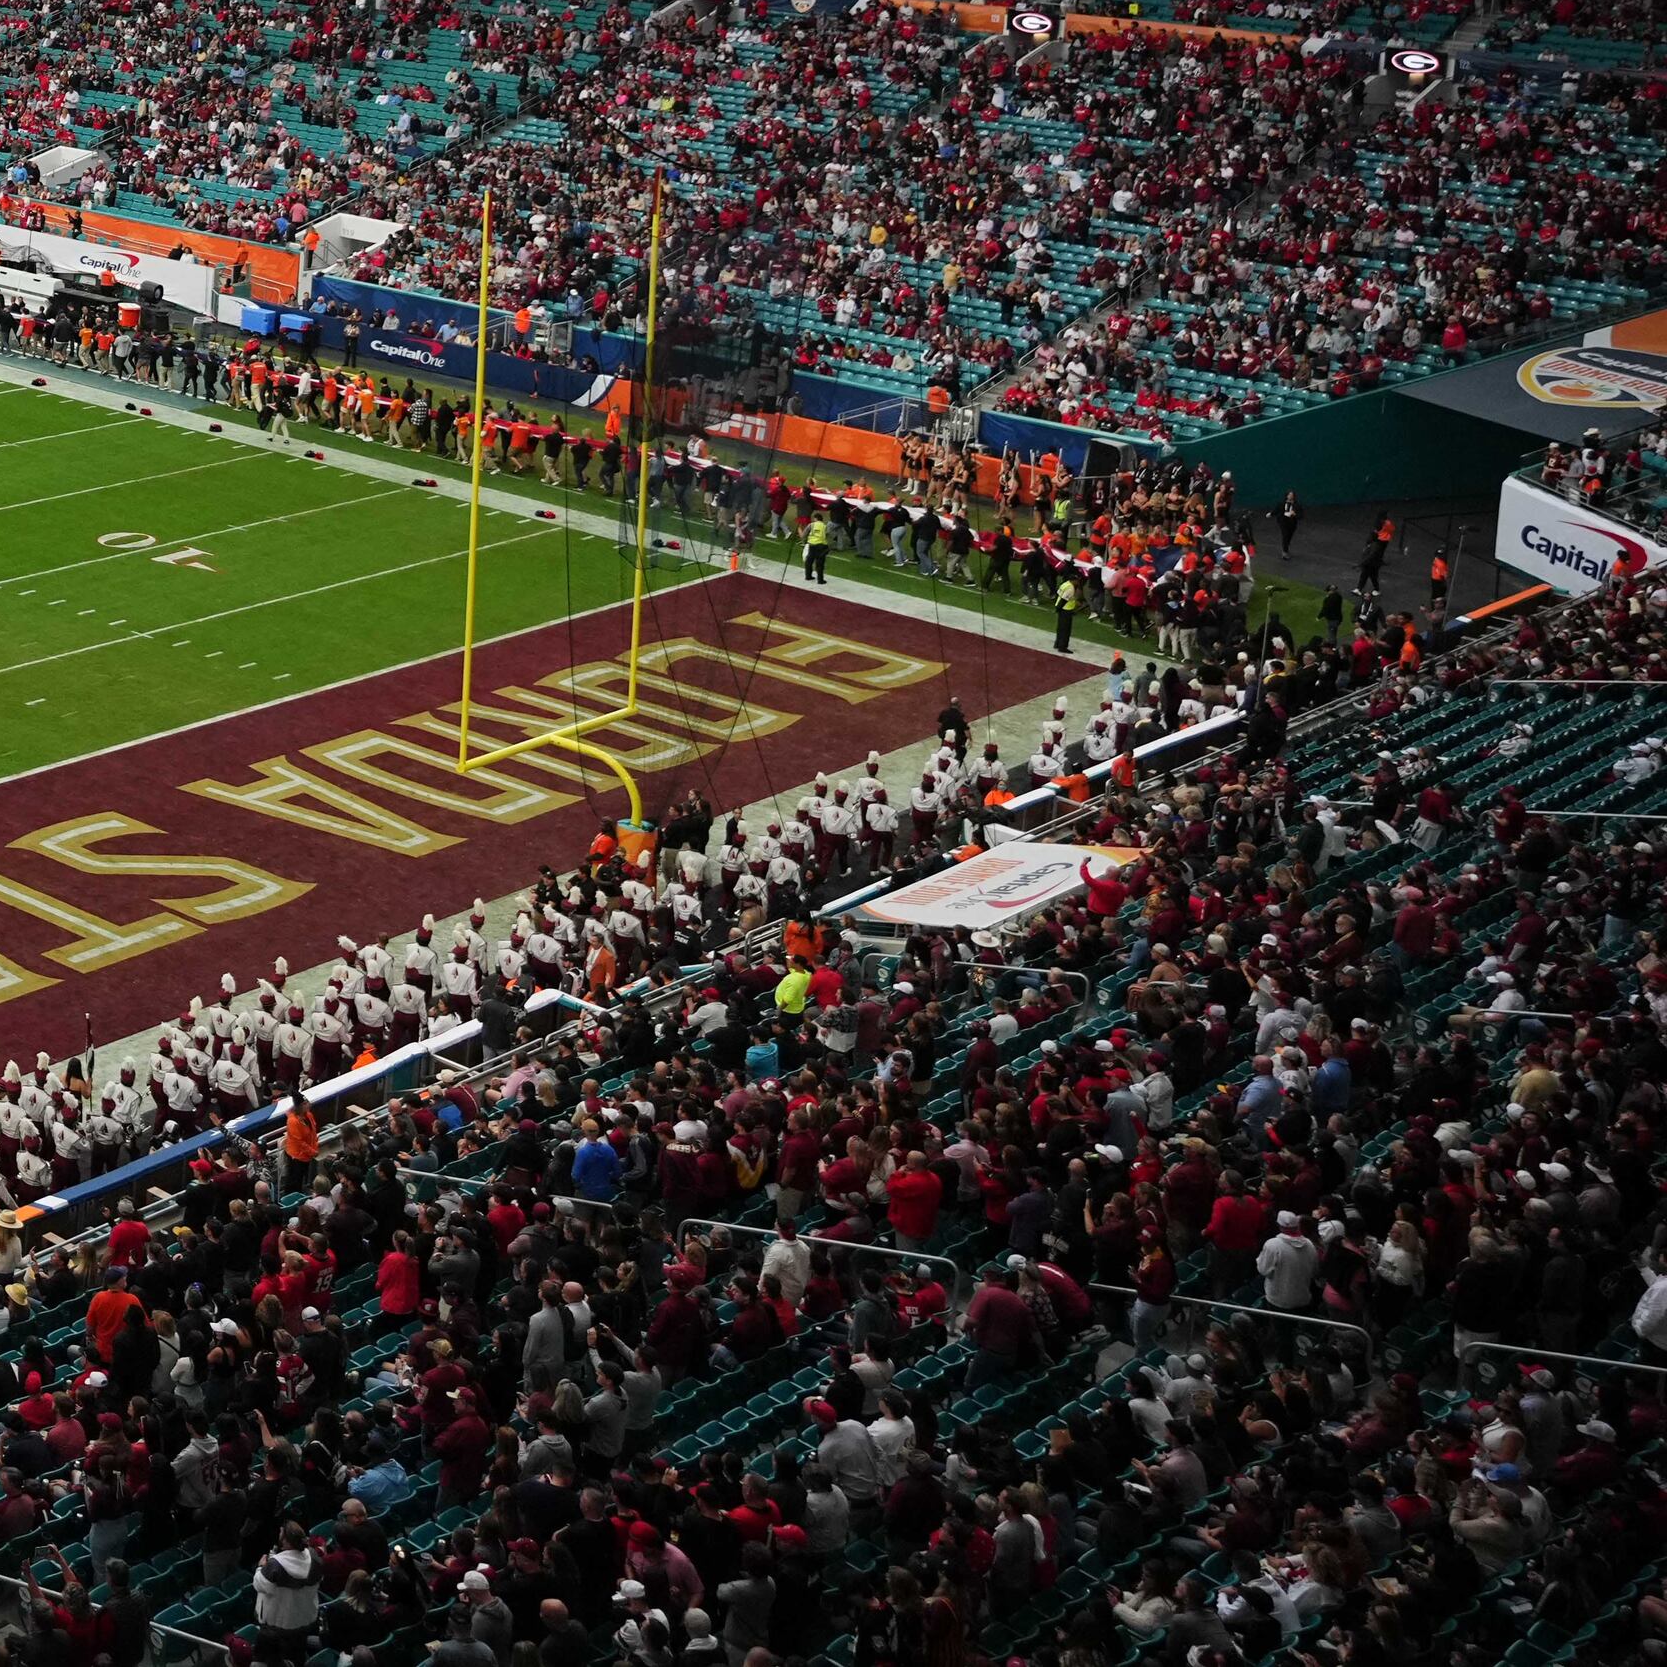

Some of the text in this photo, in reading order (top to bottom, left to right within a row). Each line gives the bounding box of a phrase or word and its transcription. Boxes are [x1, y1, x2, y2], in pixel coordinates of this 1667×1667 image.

[80, 254, 142, 280] CapitalOne
[370, 339, 446, 369] CapitalOne
[97, 531, 214, 571] 10
[180, 610, 951, 859] FLORIDA
